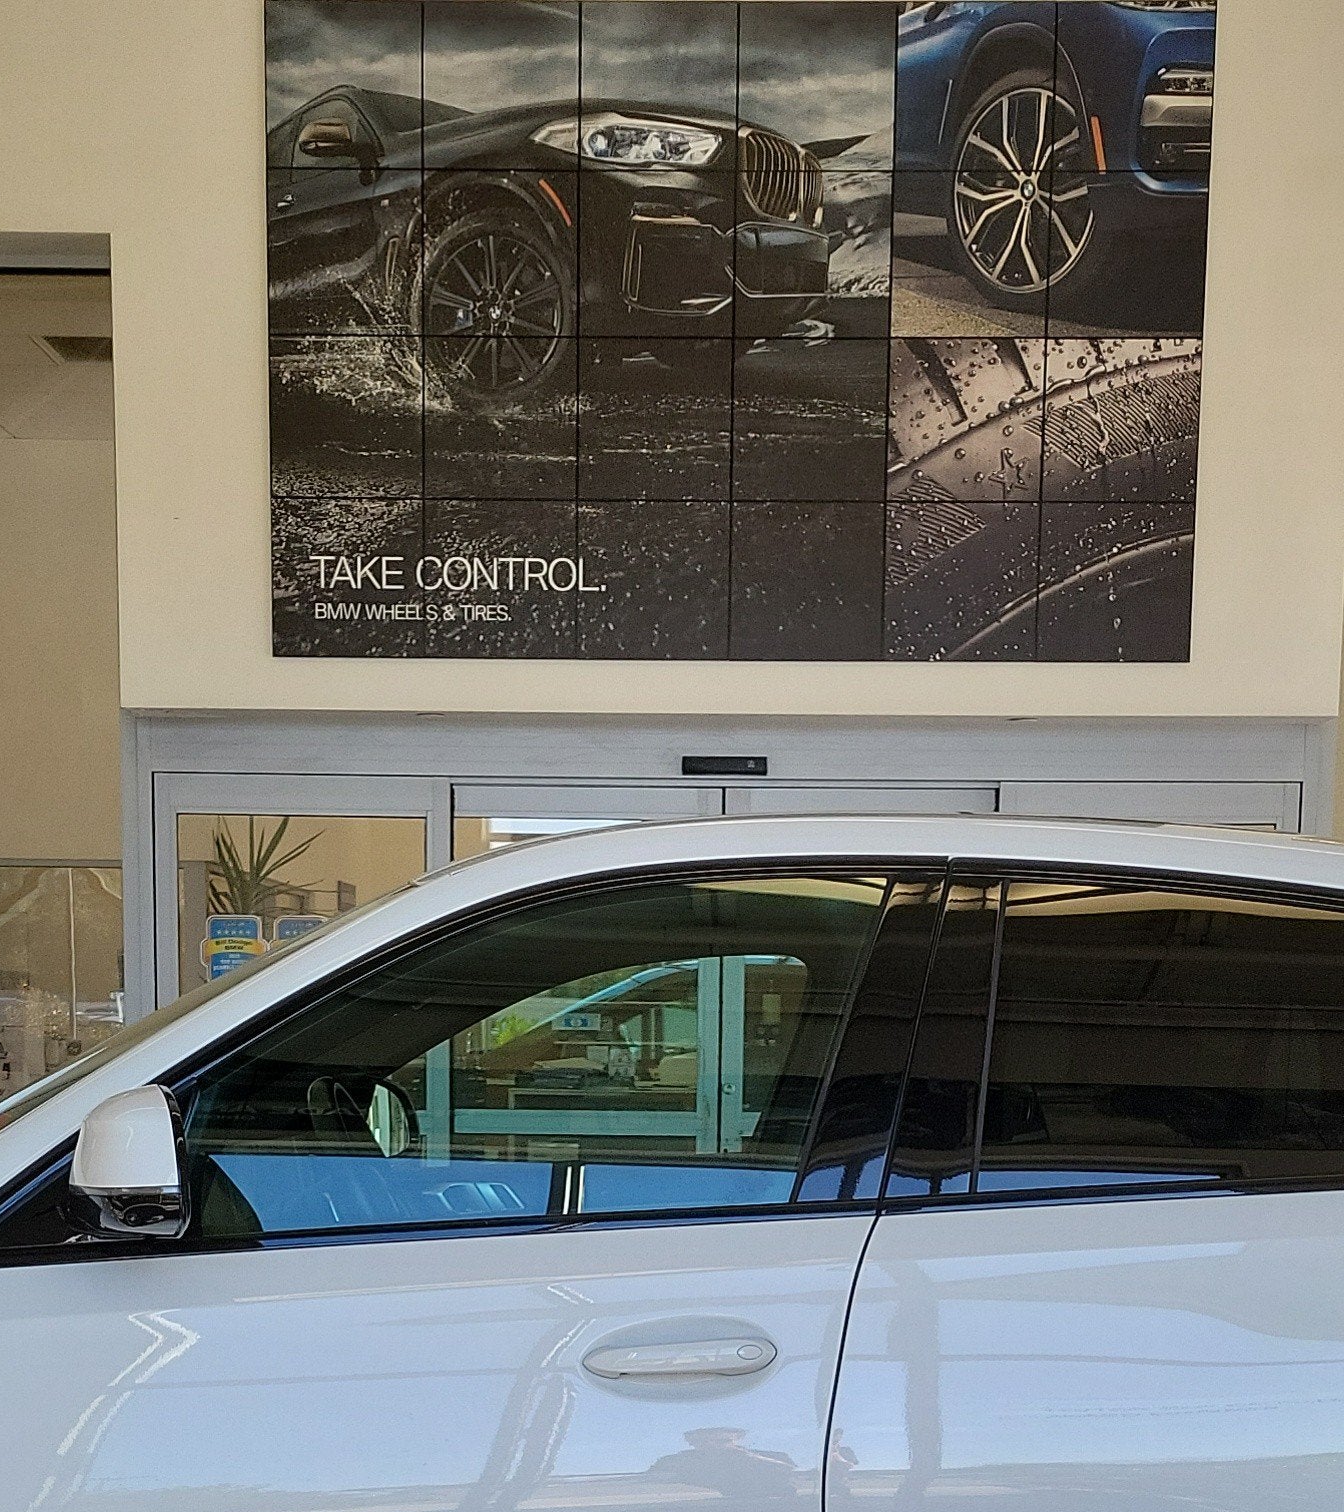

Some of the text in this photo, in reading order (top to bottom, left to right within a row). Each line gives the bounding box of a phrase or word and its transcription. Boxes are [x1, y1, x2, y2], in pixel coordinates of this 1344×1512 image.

[309, 555, 606, 592] TAKE CONTROL.
[314, 602, 513, 622] BMW WHEELS & TIRES.
